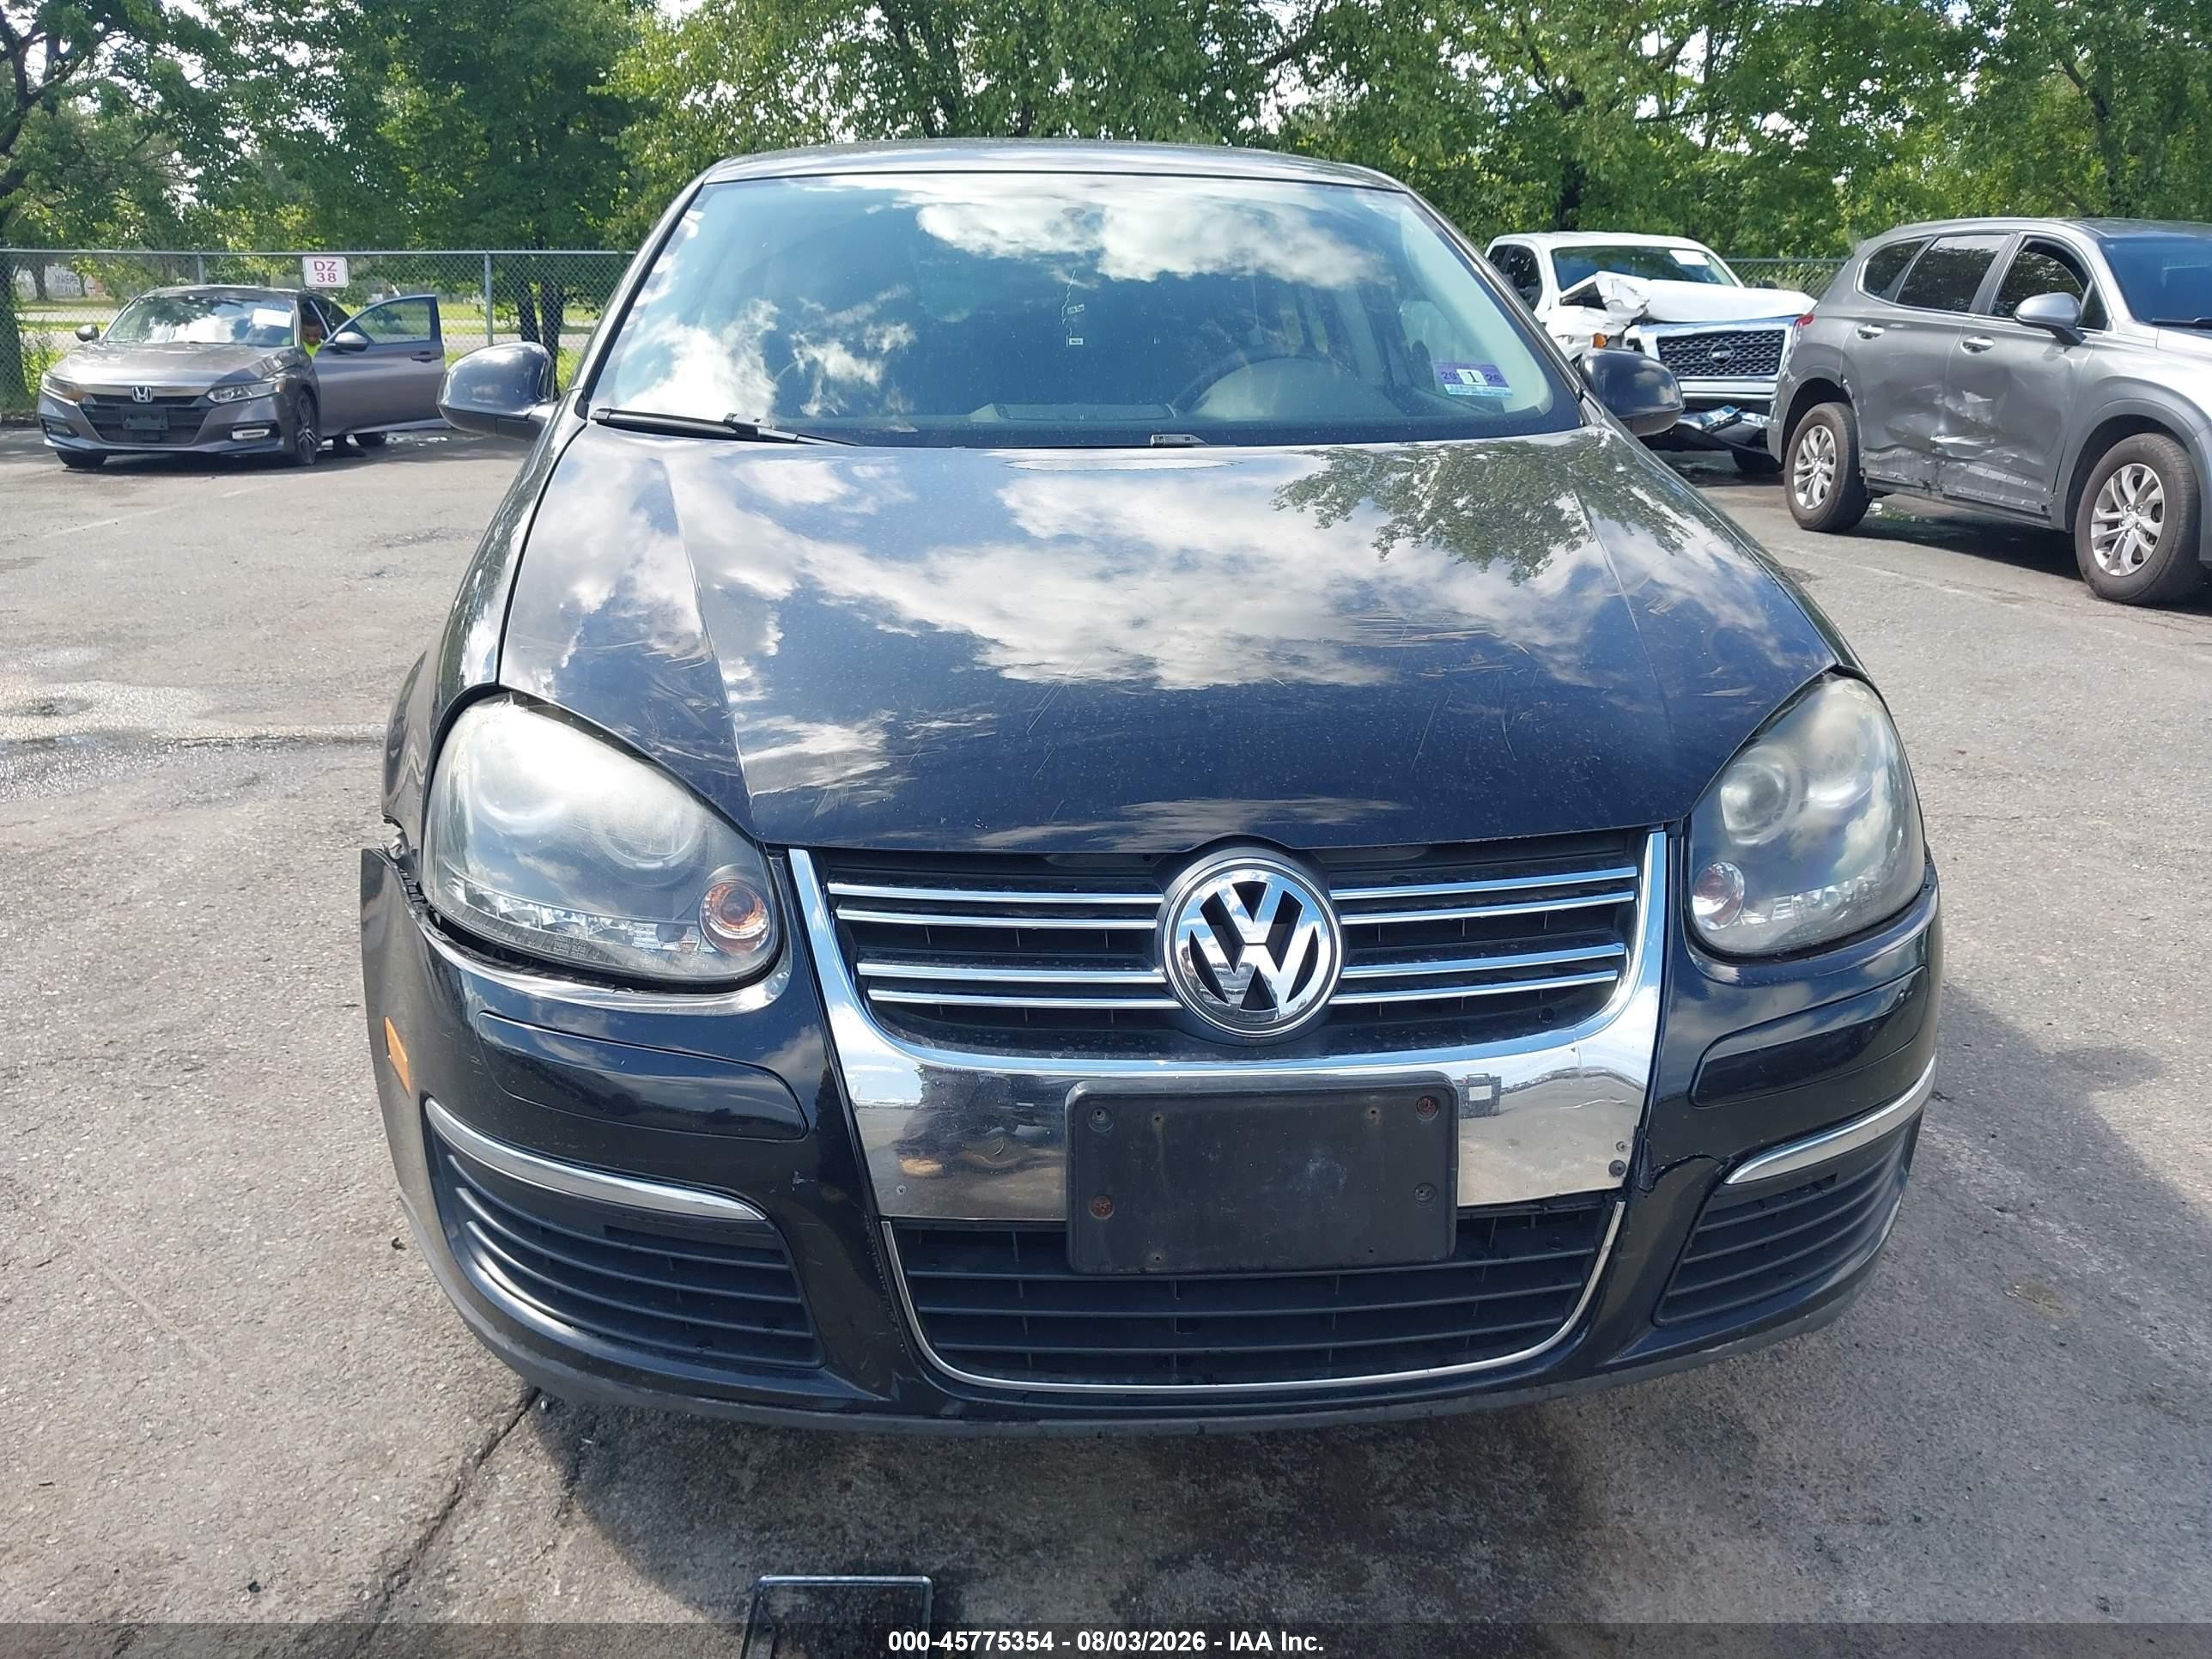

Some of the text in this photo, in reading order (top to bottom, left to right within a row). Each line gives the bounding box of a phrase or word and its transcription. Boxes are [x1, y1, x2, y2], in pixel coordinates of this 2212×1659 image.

[313, 260, 337, 272] DZ
[316, 272, 337, 283] 38
[1467, 371, 1480, 383] 1
